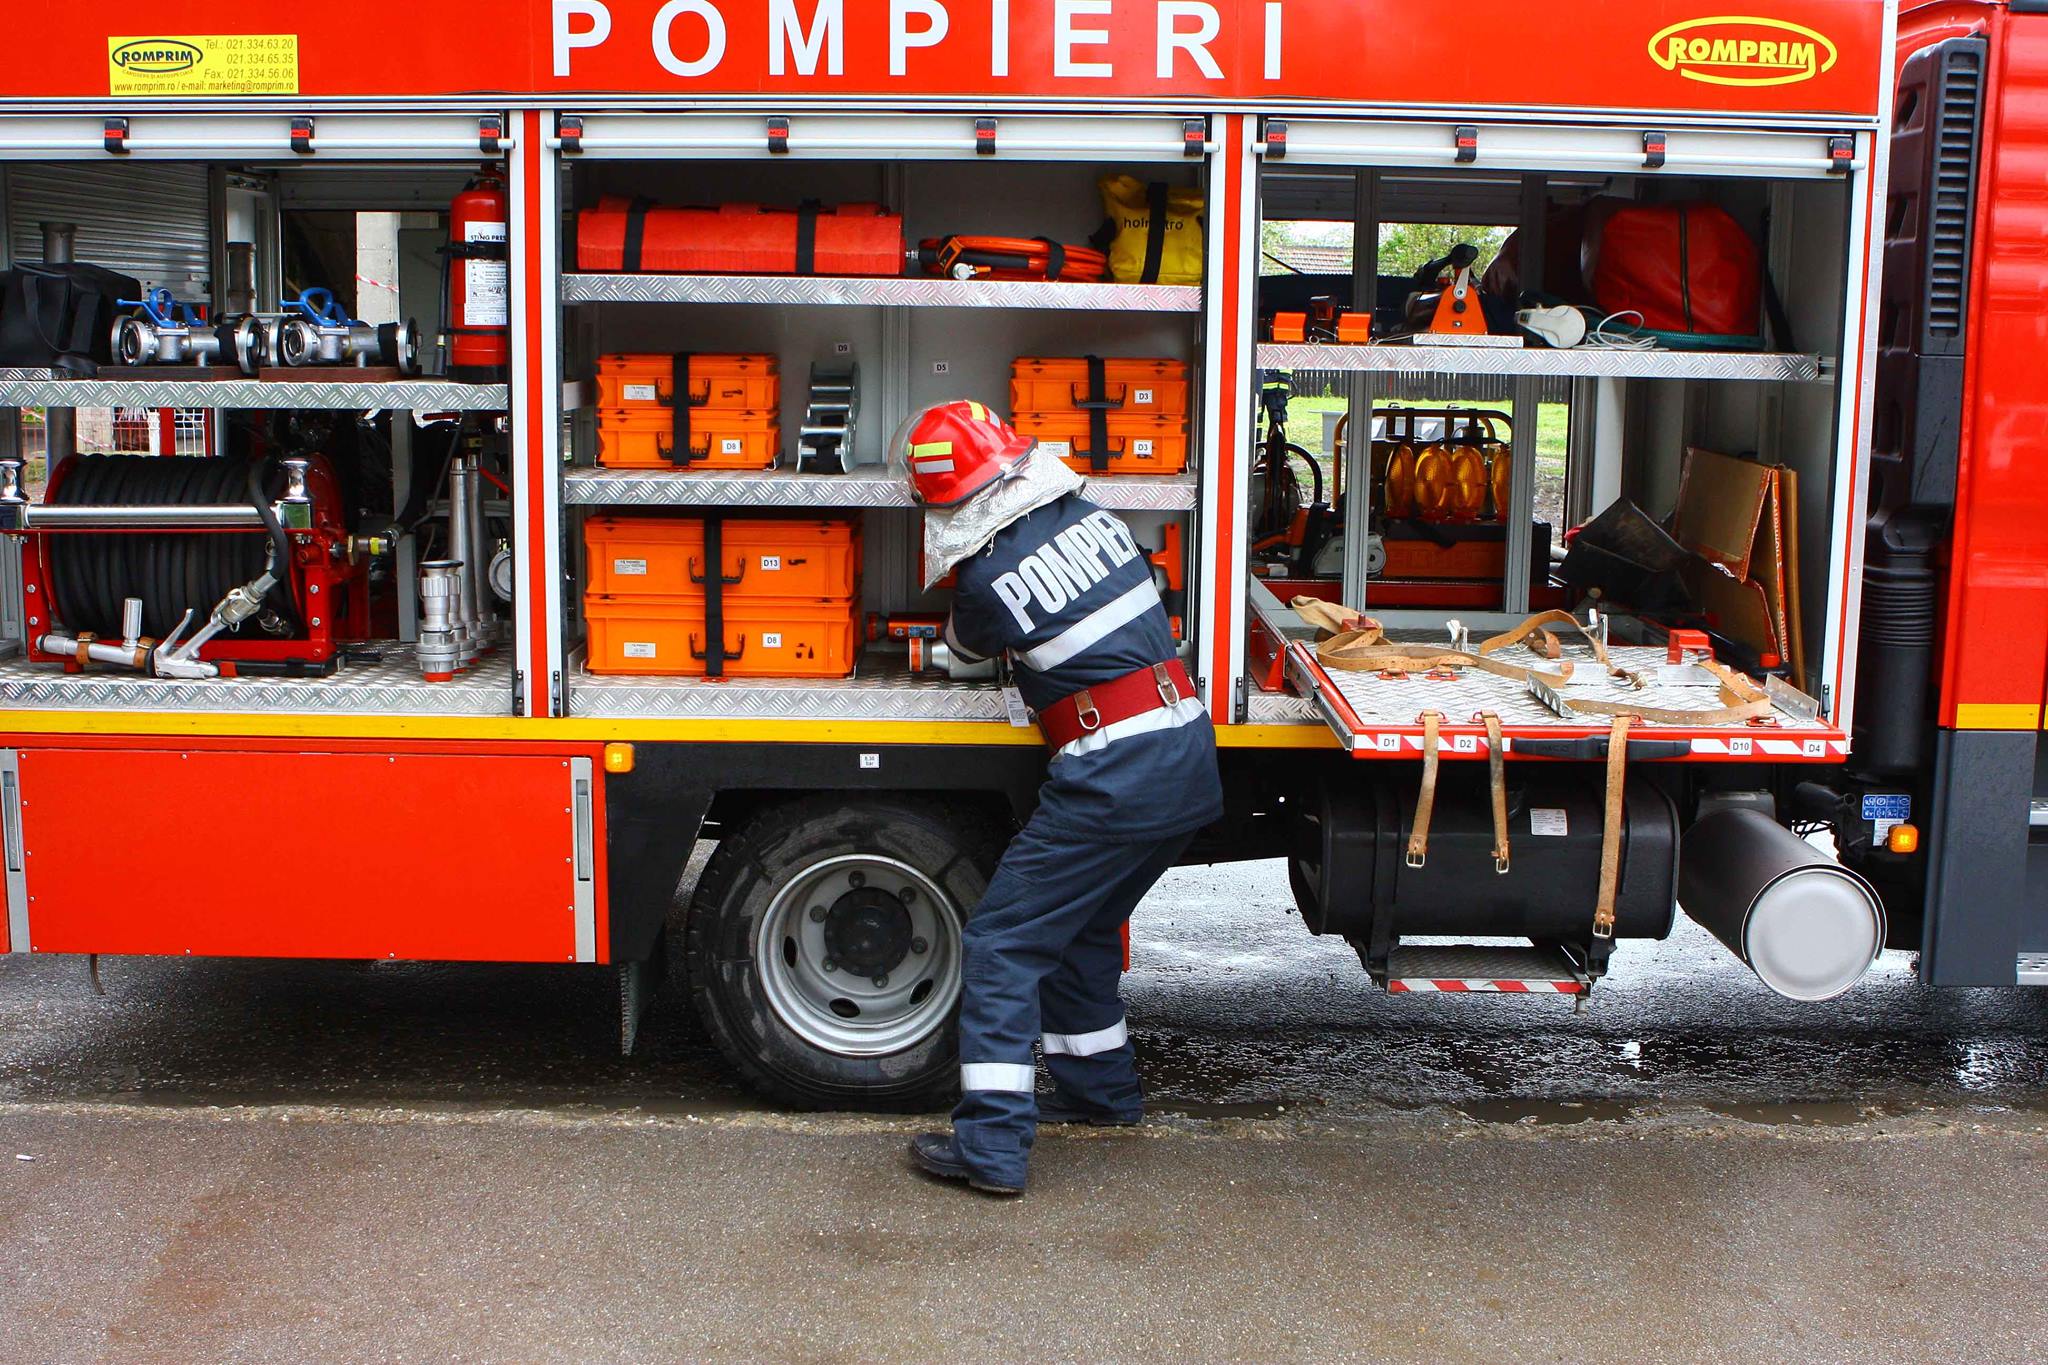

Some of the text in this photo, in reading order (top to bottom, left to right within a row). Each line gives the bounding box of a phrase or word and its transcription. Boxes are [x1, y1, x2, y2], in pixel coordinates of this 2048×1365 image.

[226, 38, 294, 50] 021.334.63.20
[552, 0, 1283, 79] POMPIERI
[121, 50, 194, 64] ROMPRIM
[1667, 37, 1817, 70] ROMPRIM
[226, 53, 294, 64] 021.334.65.35
[203, 68, 294, 79] Fax: 021.334.56.06
[114, 82, 176, 93] www.romprim.ro
[208, 80, 294, 92] marketing@romprim.ro
[838, 344, 848, 352] D9
[936, 363, 947, 371] D5
[1138, 392, 1149, 400] D3
[726, 442, 737, 450] D8
[1138, 443, 1149, 451] D3
[763, 558, 778, 567] D13
[766, 636, 777, 644] D8
[1383, 738, 1395, 747] D1
[1459, 740, 1472, 748] D2
[1732, 742, 1750, 751] D10
[1808, 743, 1821, 753] D4
